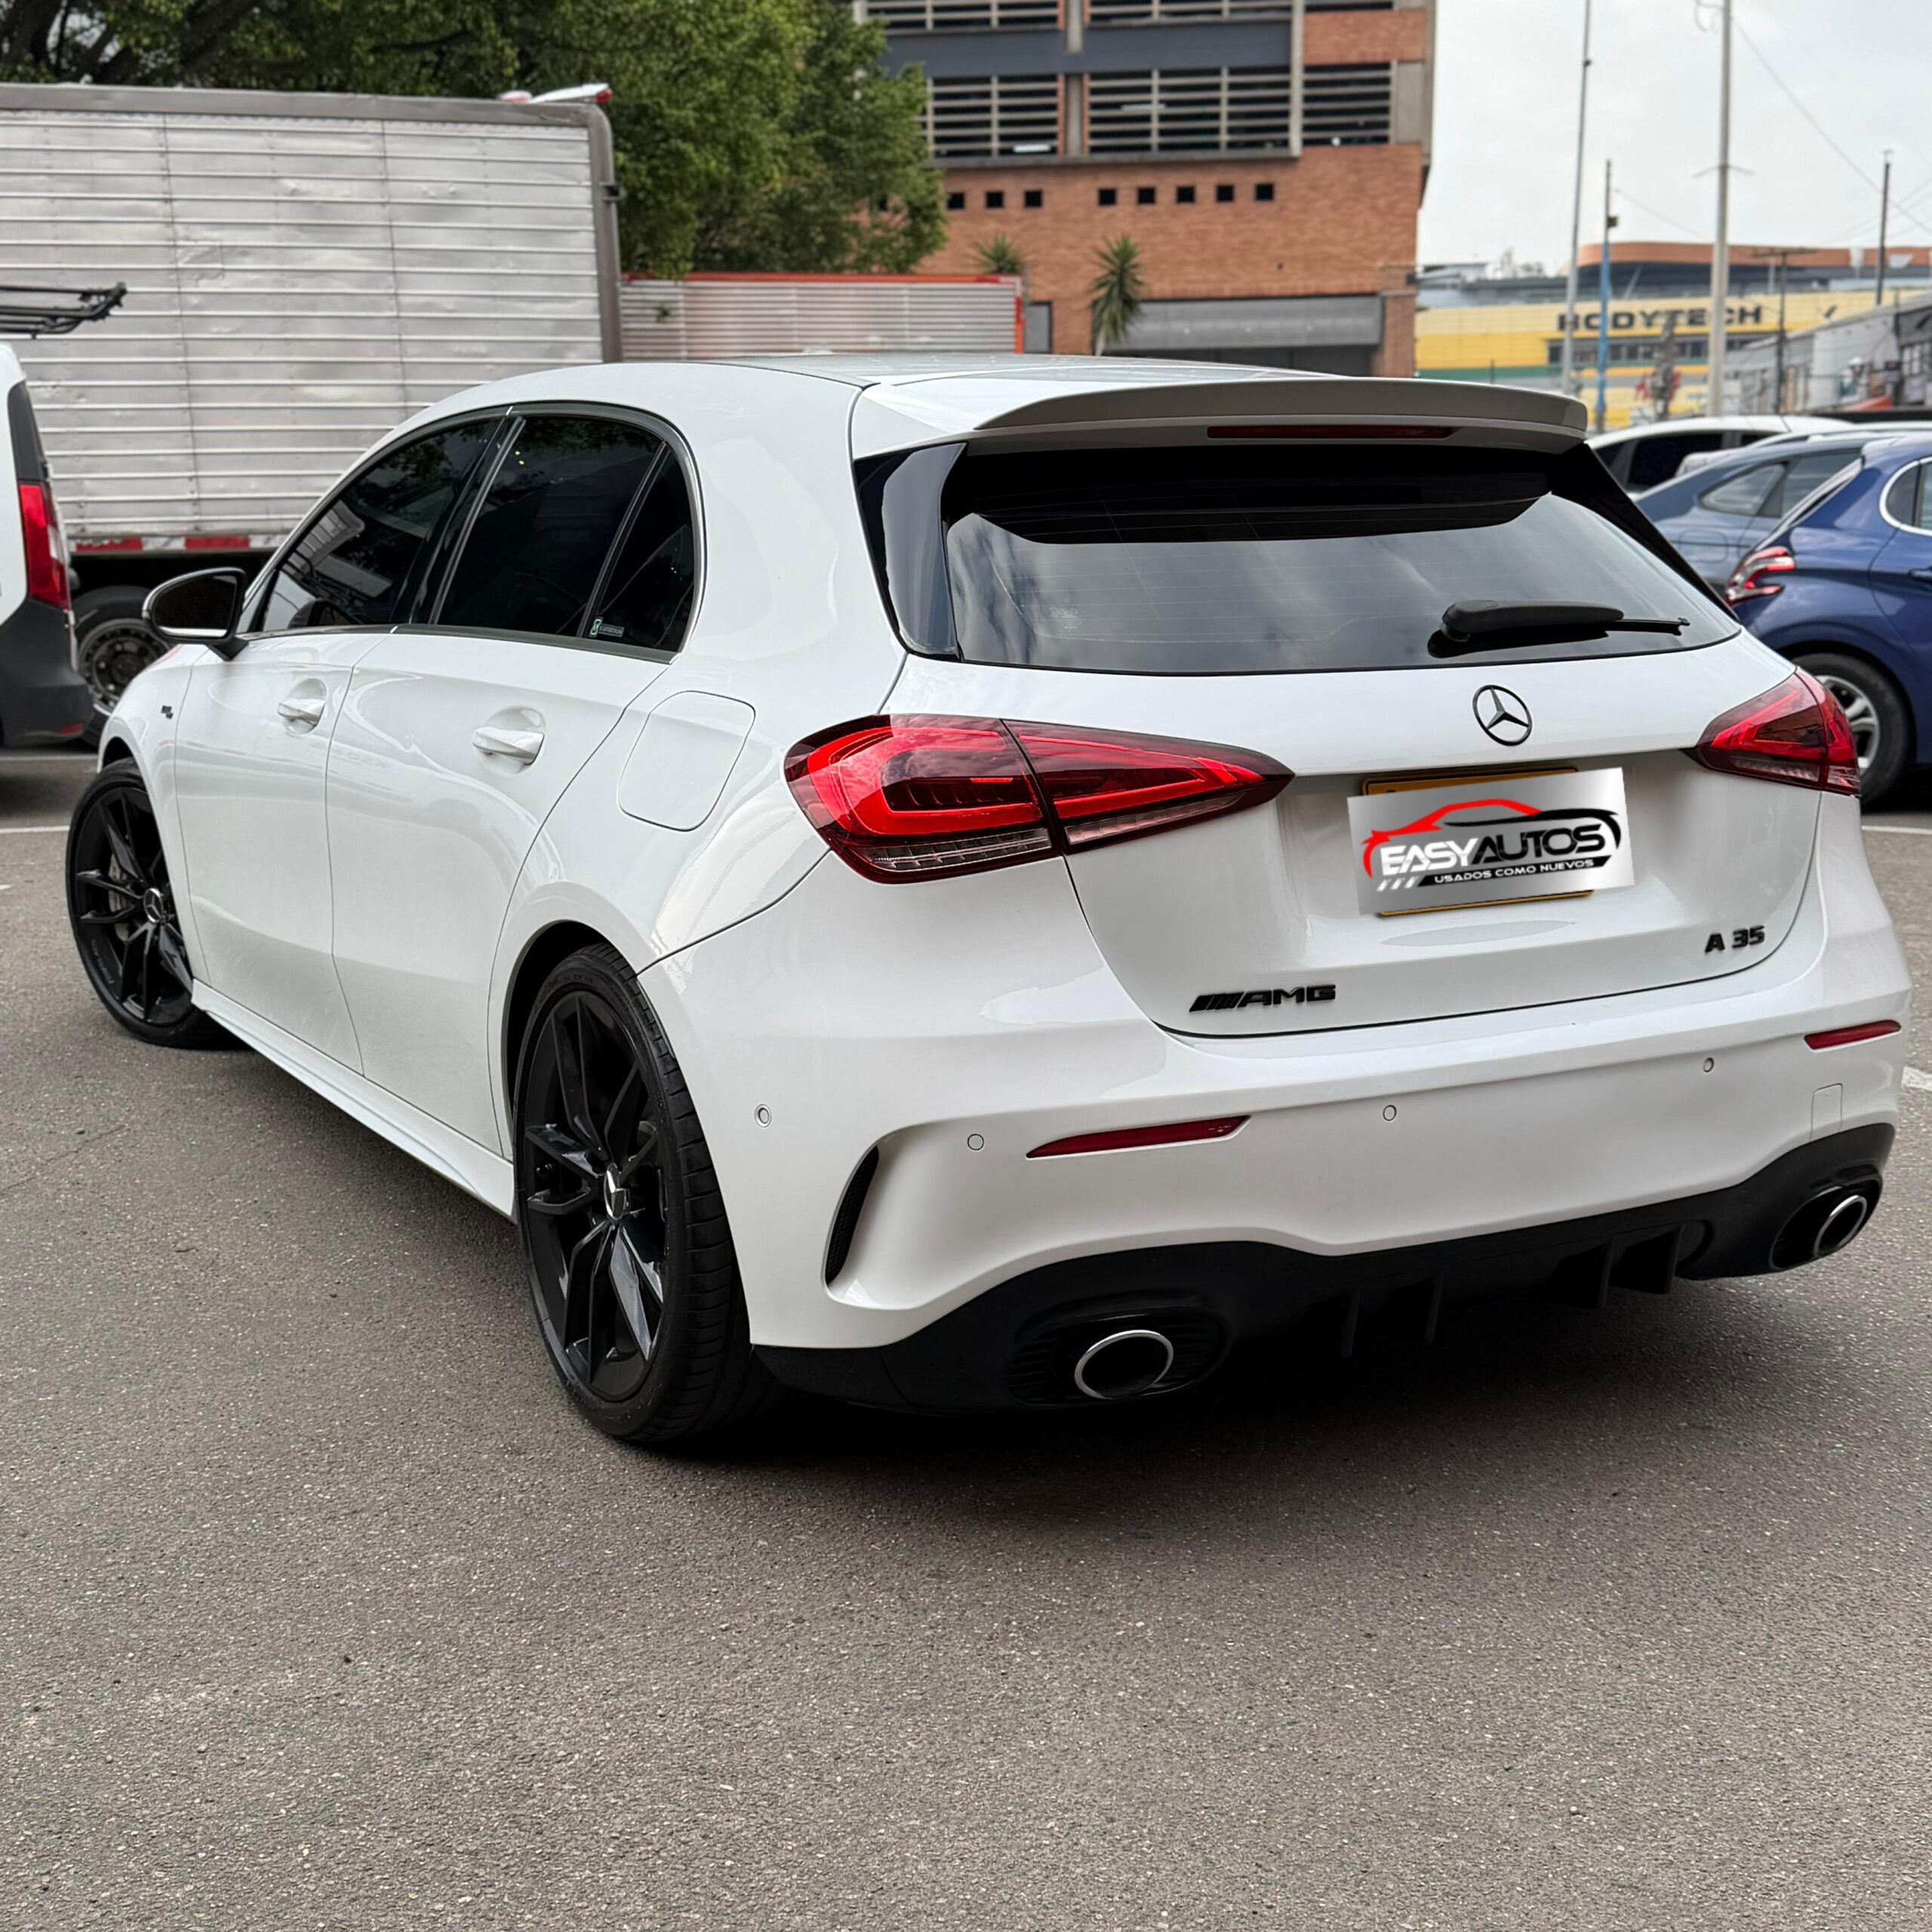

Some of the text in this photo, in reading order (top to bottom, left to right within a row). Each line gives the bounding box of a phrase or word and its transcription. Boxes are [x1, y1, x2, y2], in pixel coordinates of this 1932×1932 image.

[1705, 924, 1765, 953] A 35
[1237, 983, 1337, 1009] AMG
